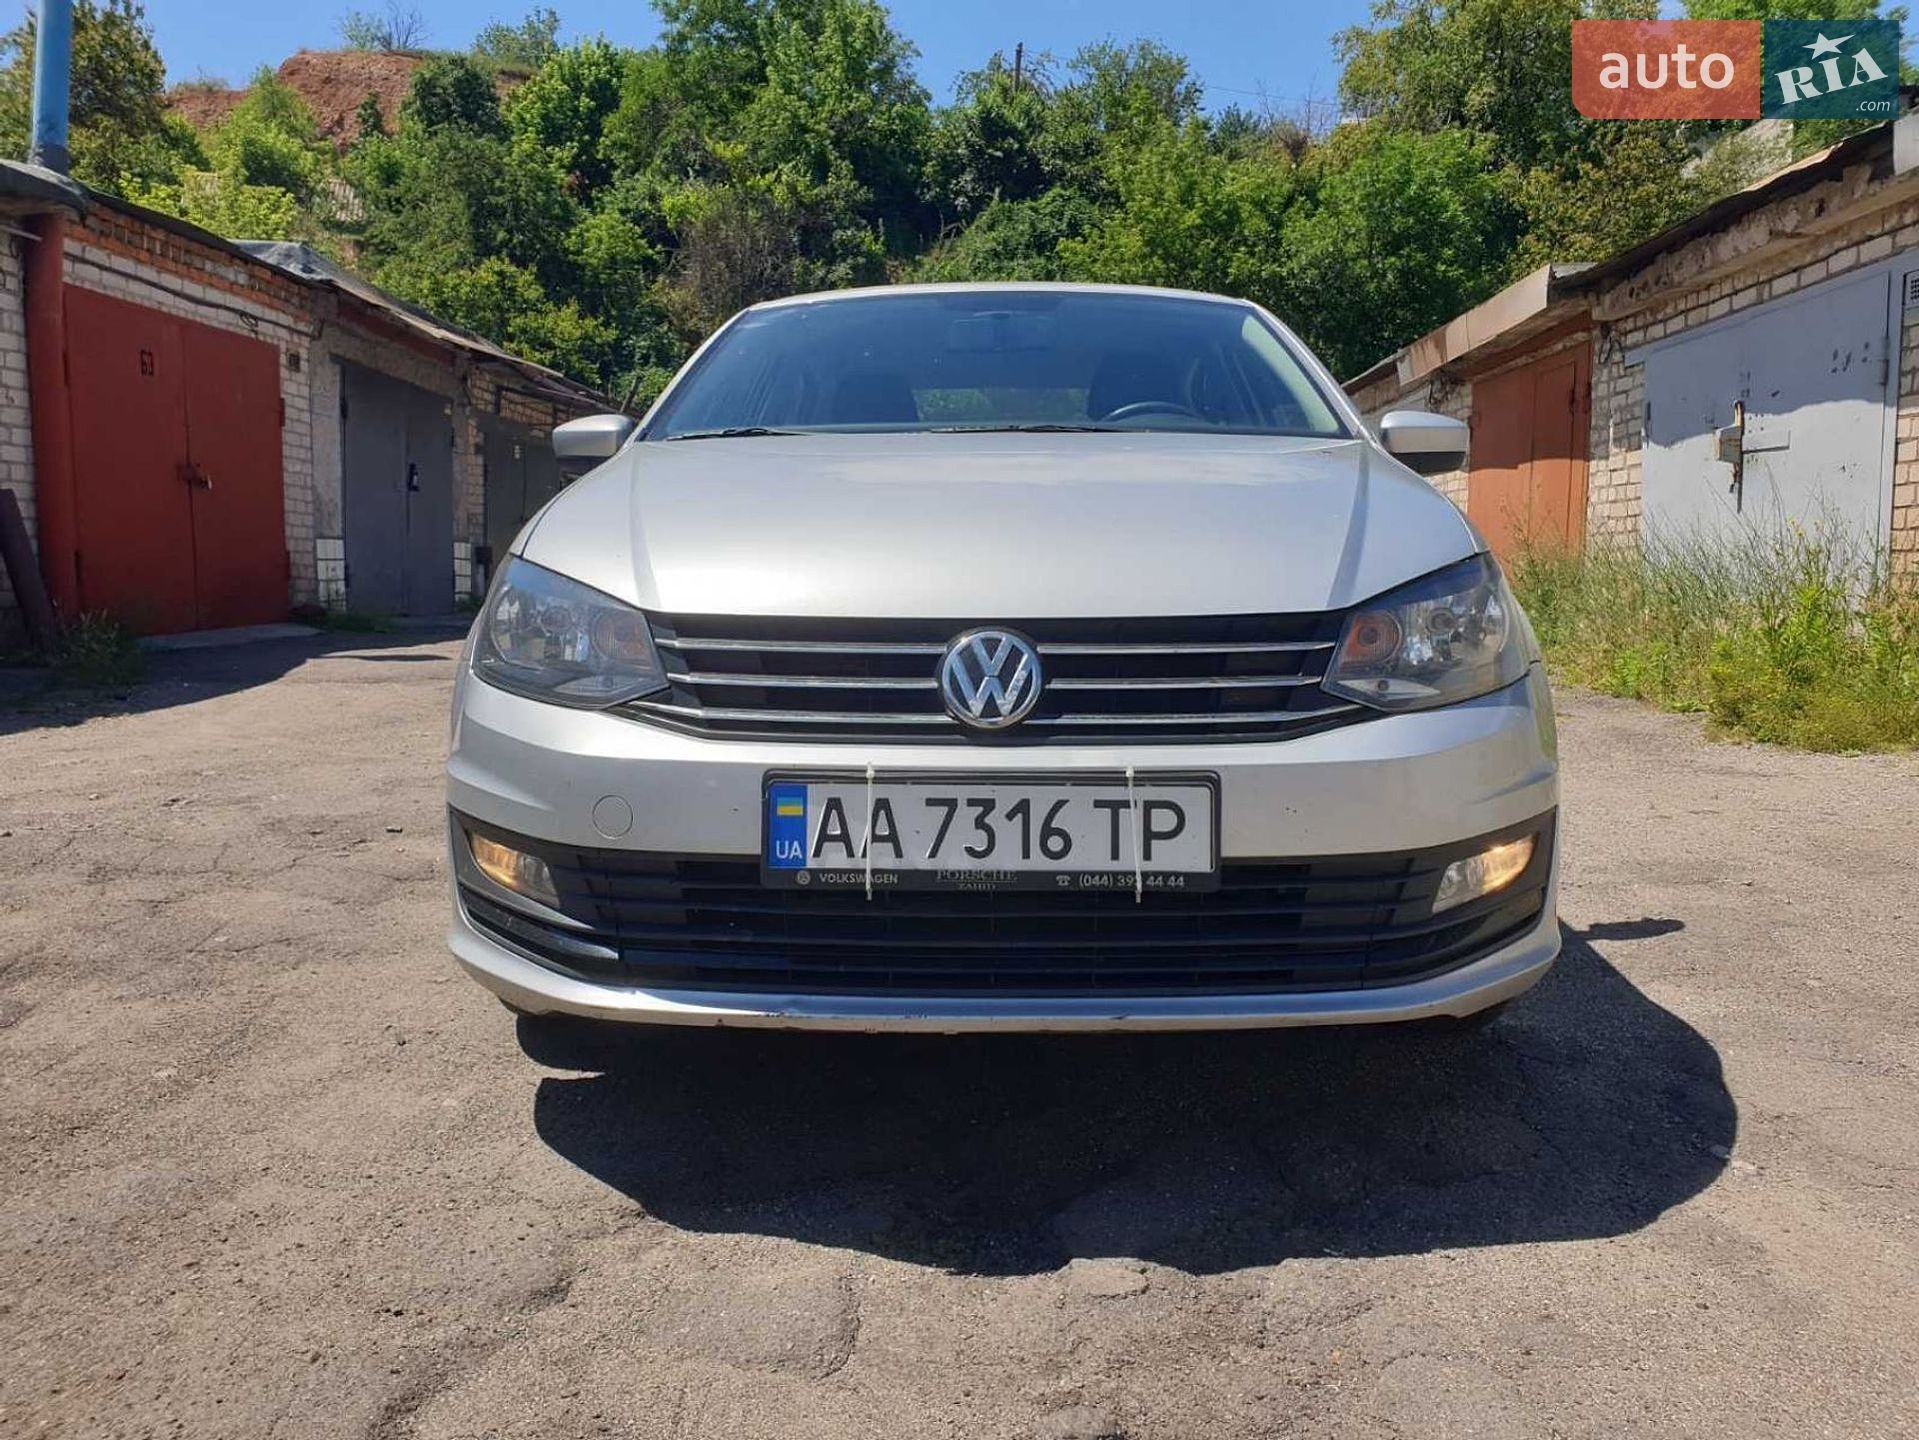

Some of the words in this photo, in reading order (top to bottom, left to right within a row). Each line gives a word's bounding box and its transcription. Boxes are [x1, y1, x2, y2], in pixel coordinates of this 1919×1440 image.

[811, 797, 904, 858] AA
[924, 797, 1073, 861] 7316
[1093, 799, 1186, 862] TP
[776, 840, 803, 859] UA
[1079, 873, 1113, 888] (044)
[1117, 875, 1142, 887] 39
[1146, 875, 1164, 887] 44
[1167, 875, 1185, 887] 44
